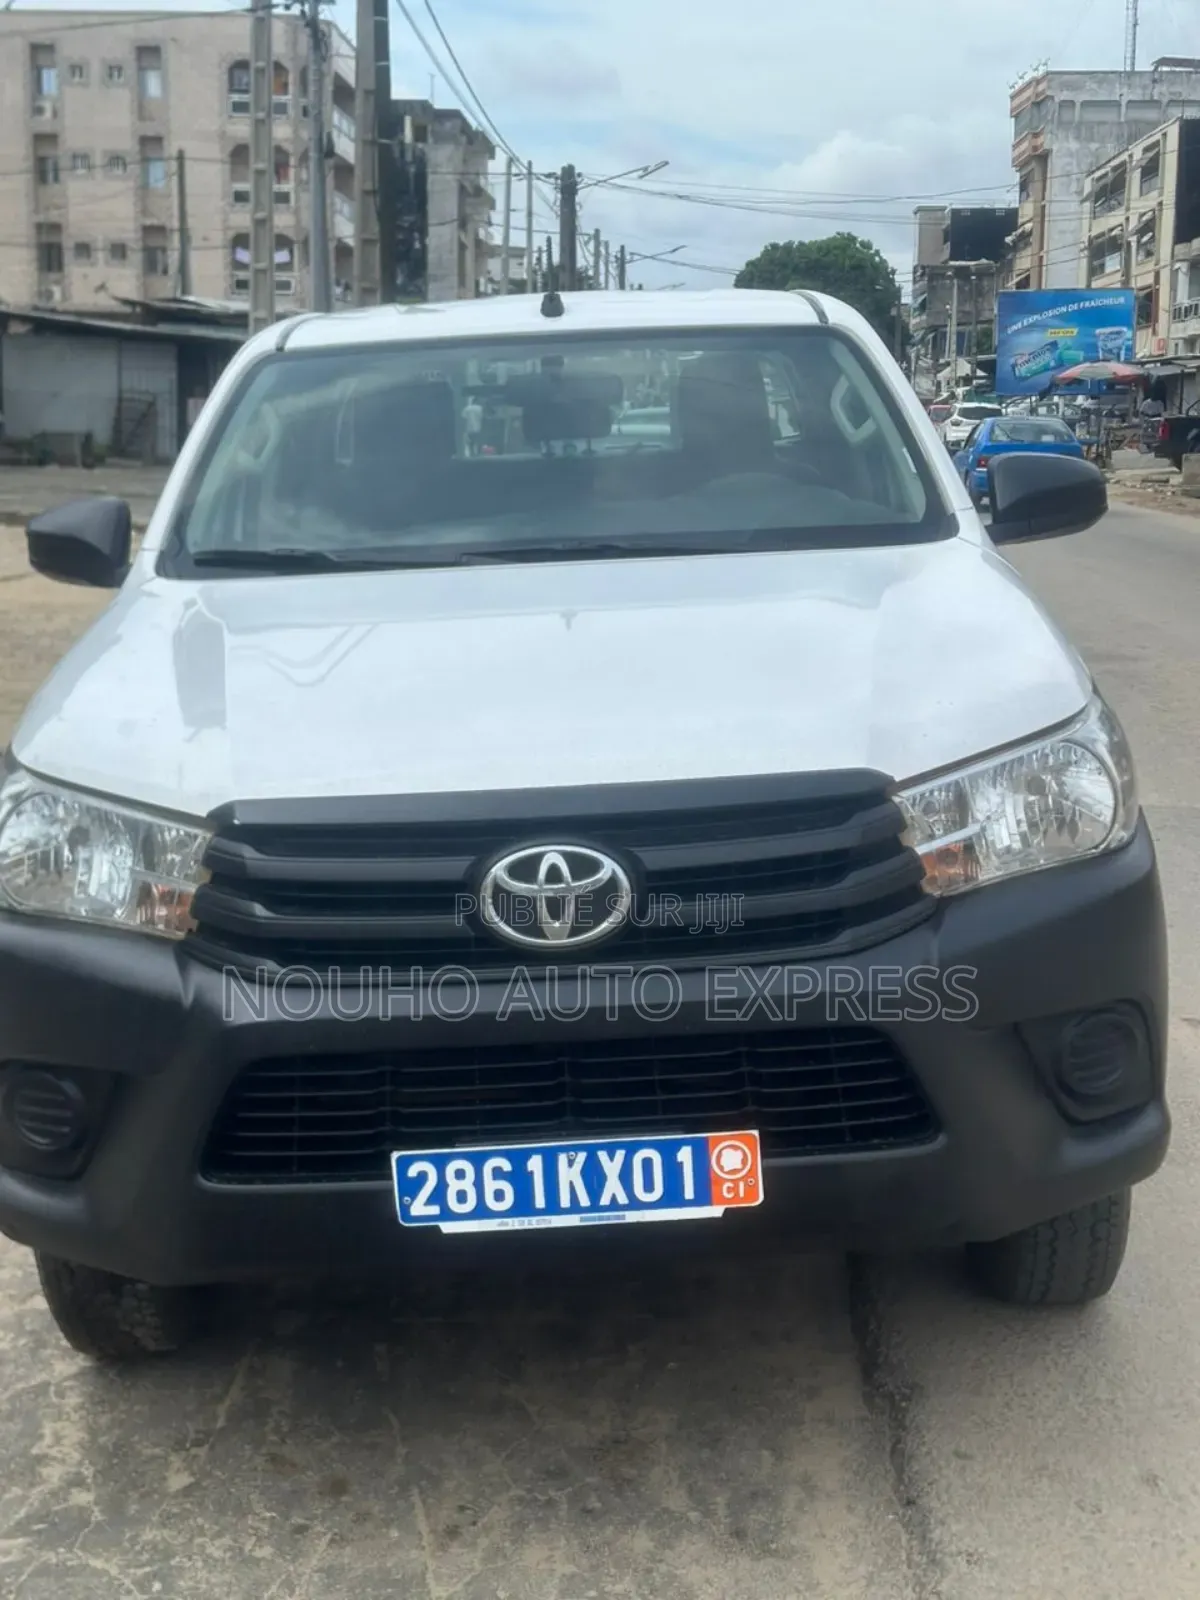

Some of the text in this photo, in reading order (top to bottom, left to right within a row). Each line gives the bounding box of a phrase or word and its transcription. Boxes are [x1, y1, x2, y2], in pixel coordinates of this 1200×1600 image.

[1007, 321, 1021, 334] UNE
[1023, 306, 1067, 324] EXPLOSION
[1068, 304, 1079, 312] DE
[722, 1180, 745, 1199] CI
